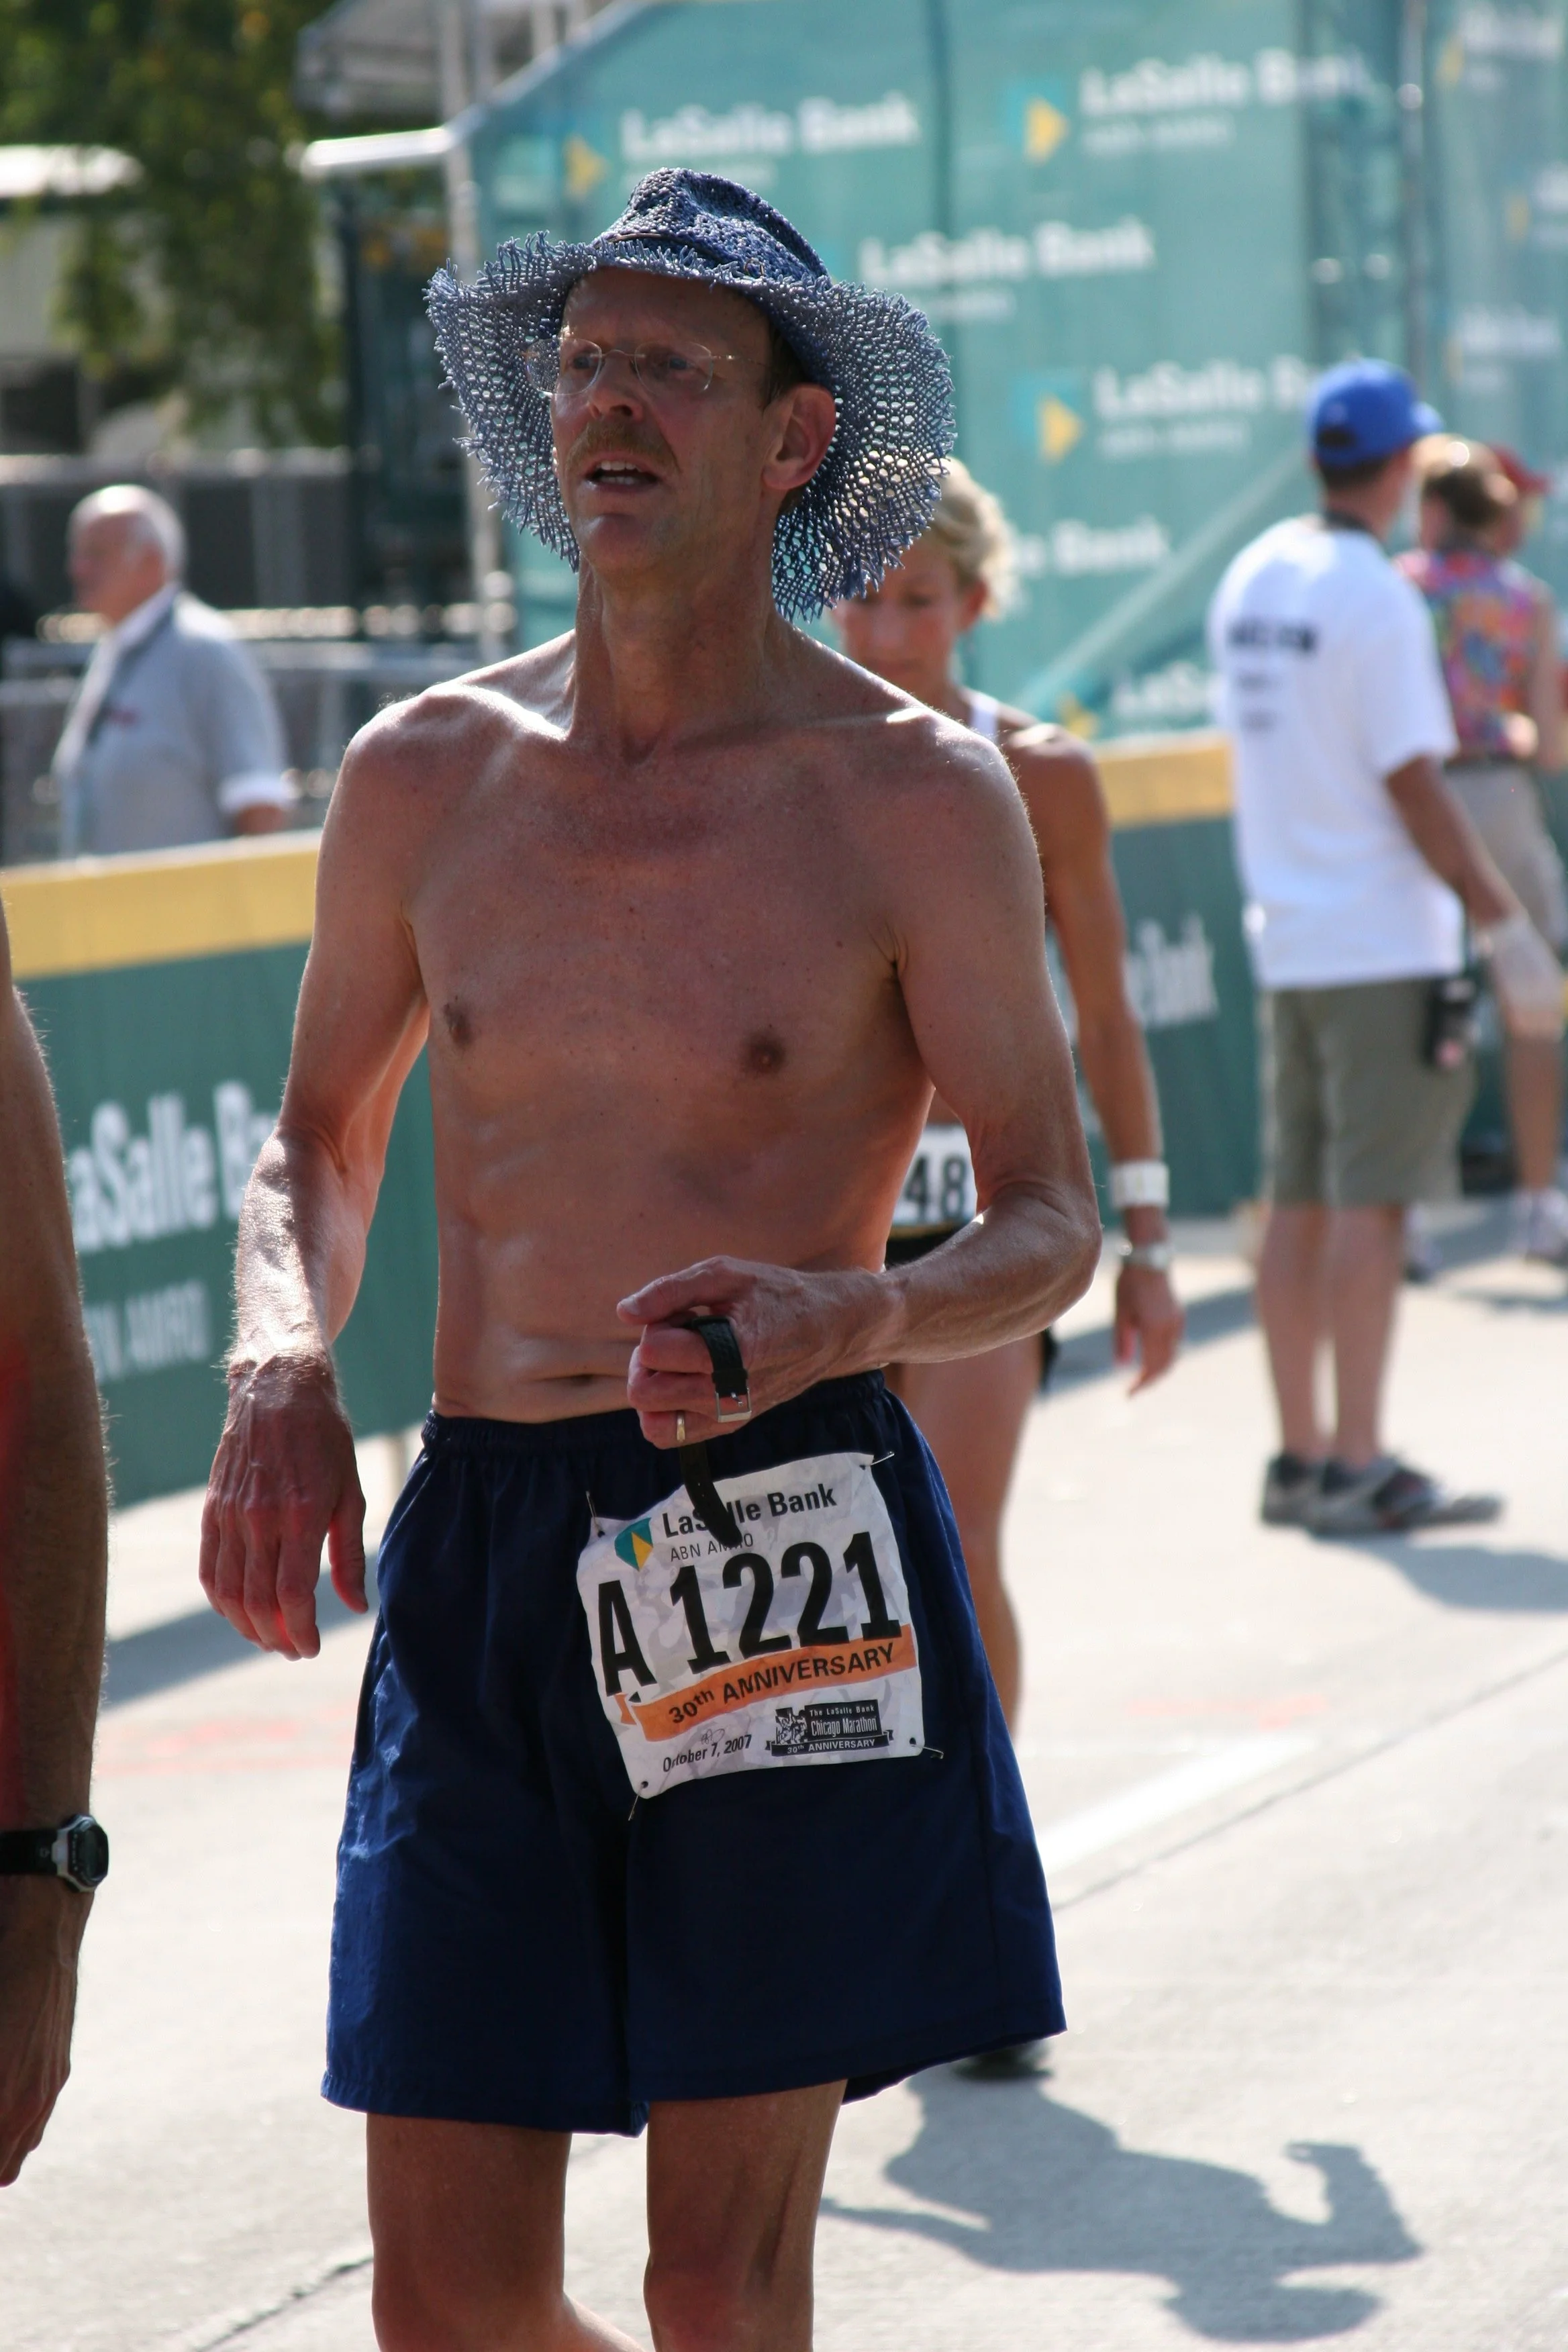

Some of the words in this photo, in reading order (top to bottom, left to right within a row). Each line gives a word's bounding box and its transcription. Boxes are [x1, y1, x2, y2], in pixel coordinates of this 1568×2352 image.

[70, 1095, 217, 1251] aSalle
[663, 1499, 761, 1538] LaSle
[767, 1483, 837, 1517] Bank
[671, 1545, 701, 1562] ABN
[707, 1533, 753, 1555] AMO
[598, 1579, 657, 1697] A
[670, 1531, 902, 1674] 1221
[669, 1689, 714, 1723] 30th
[723, 1643, 894, 1704] ANNIVERSARY
[827, 1707, 852, 1715] LaSalle
[856, 1705, 875, 1713] Bank
[811, 1720, 840, 1737] Chicago
[842, 1716, 877, 1734] Marathon
[712, 1743, 720, 1758] 7,
[724, 1734, 752, 1754] 2007
[787, 1745, 805, 1754] 30th
[808, 1739, 875, 1752] ANNIVERSARY
